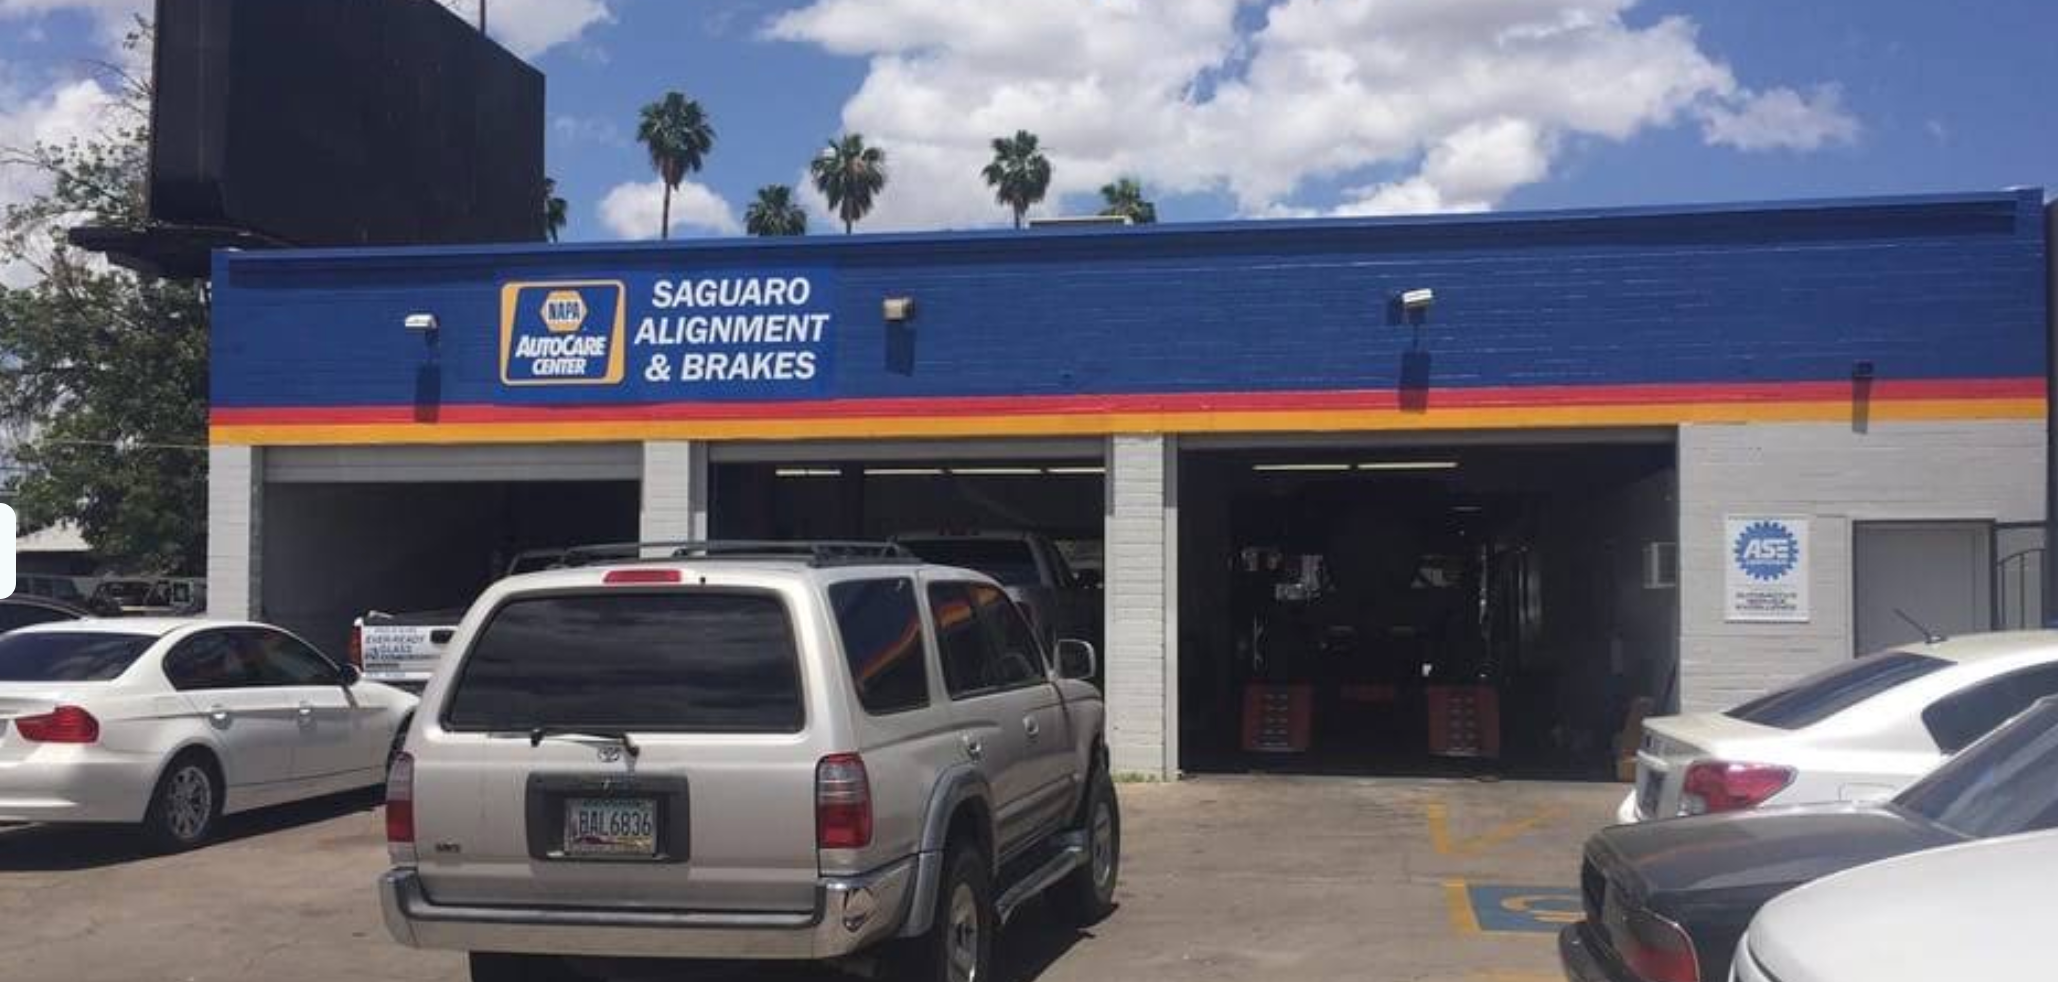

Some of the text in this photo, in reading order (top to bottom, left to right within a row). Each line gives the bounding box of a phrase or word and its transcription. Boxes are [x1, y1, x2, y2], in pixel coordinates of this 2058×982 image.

[651, 277, 811, 308] SAGUARO
[547, 300, 581, 321] NAPA
[634, 313, 830, 345] ALIGNMENT
[532, 358, 587, 376] CENTER
[644, 351, 817, 382] & BRAKES
[1743, 539, 1789, 560] ASE
[578, 810, 651, 837] BAL6836
